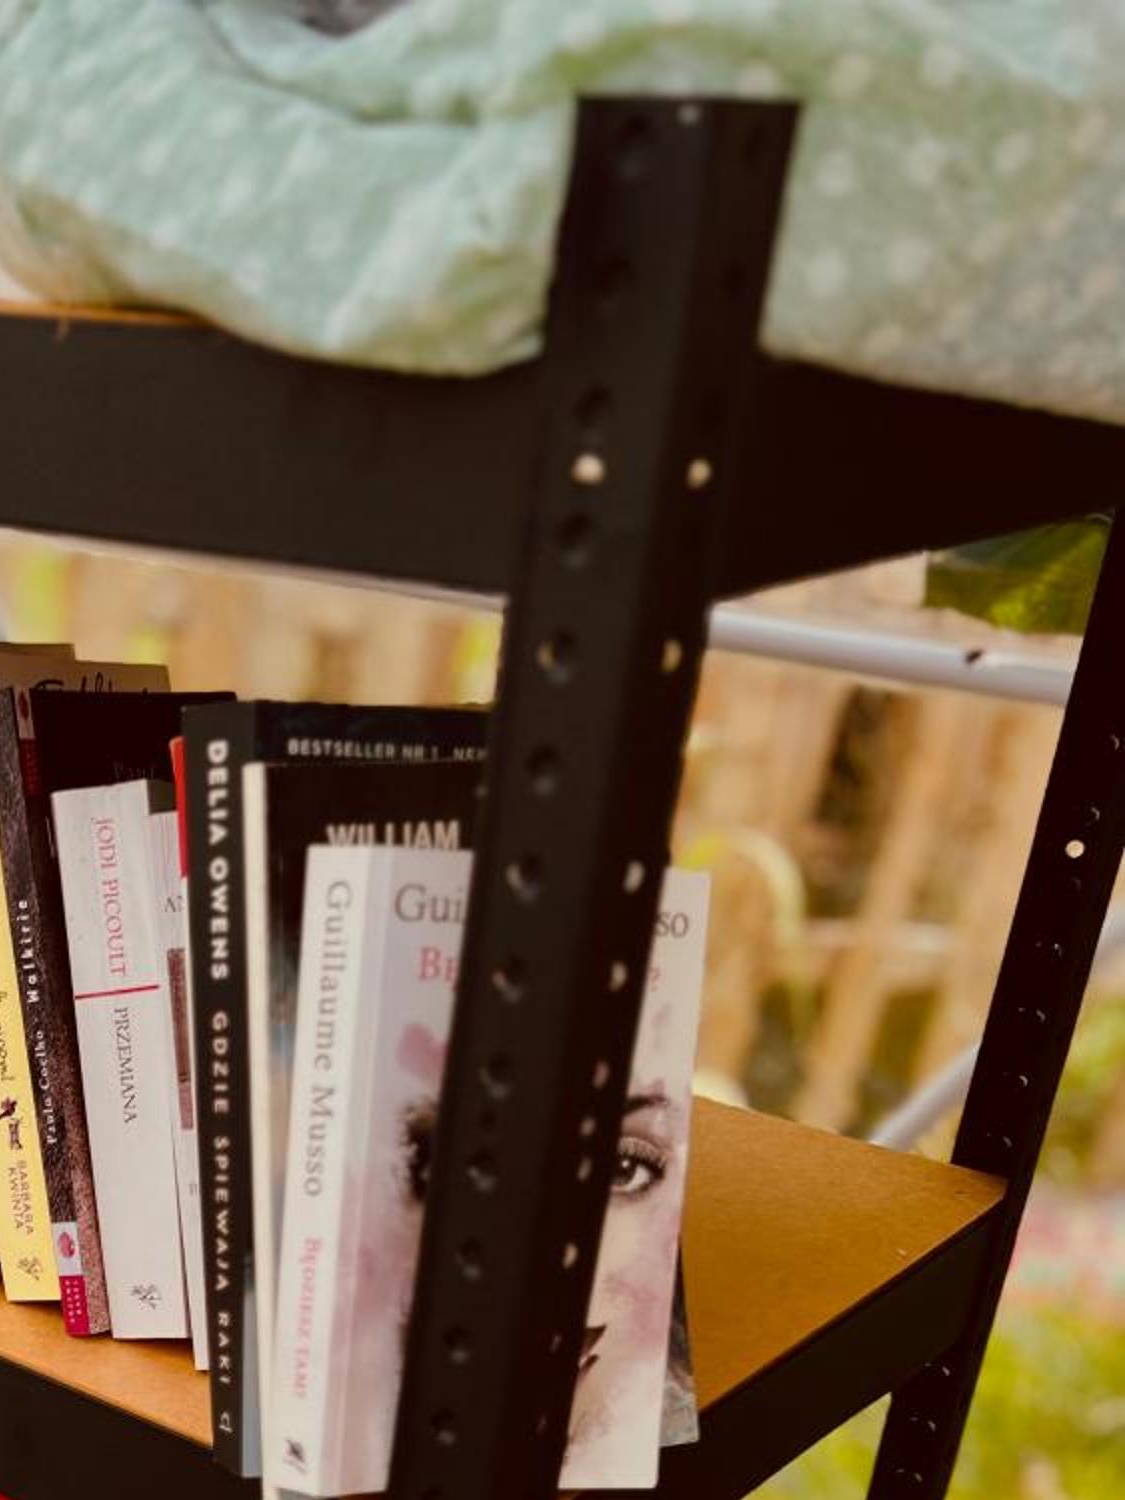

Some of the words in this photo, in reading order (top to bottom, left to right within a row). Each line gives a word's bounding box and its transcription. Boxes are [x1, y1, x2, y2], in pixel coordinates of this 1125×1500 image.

[206, 738, 232, 844] DELIA
[287, 738, 395, 760] BESTSELLER
[402, 744, 425, 760] NR
[91, 815, 118, 871] JODI
[325, 819, 460, 849] WILLIAM
[12, 898, 46, 1003] Walkirie
[99, 877, 130, 978] PICOULT
[208, 856, 232, 980] OWENS
[312, 878, 356, 1071] Guillaume
[35, 1029, 56, 1090] Coelho
[113, 1006, 142, 1124] PRZEMIANA
[211, 1011, 231, 1114] GDZIE
[40, 1093, 62, 1144] Paulo
[302, 1084, 340, 1197] Musso
[6, 1165, 28, 1230] KWINTA
[15, 1158, 39, 1235] BARBARA
[217, 1312, 234, 1385] RAKI
